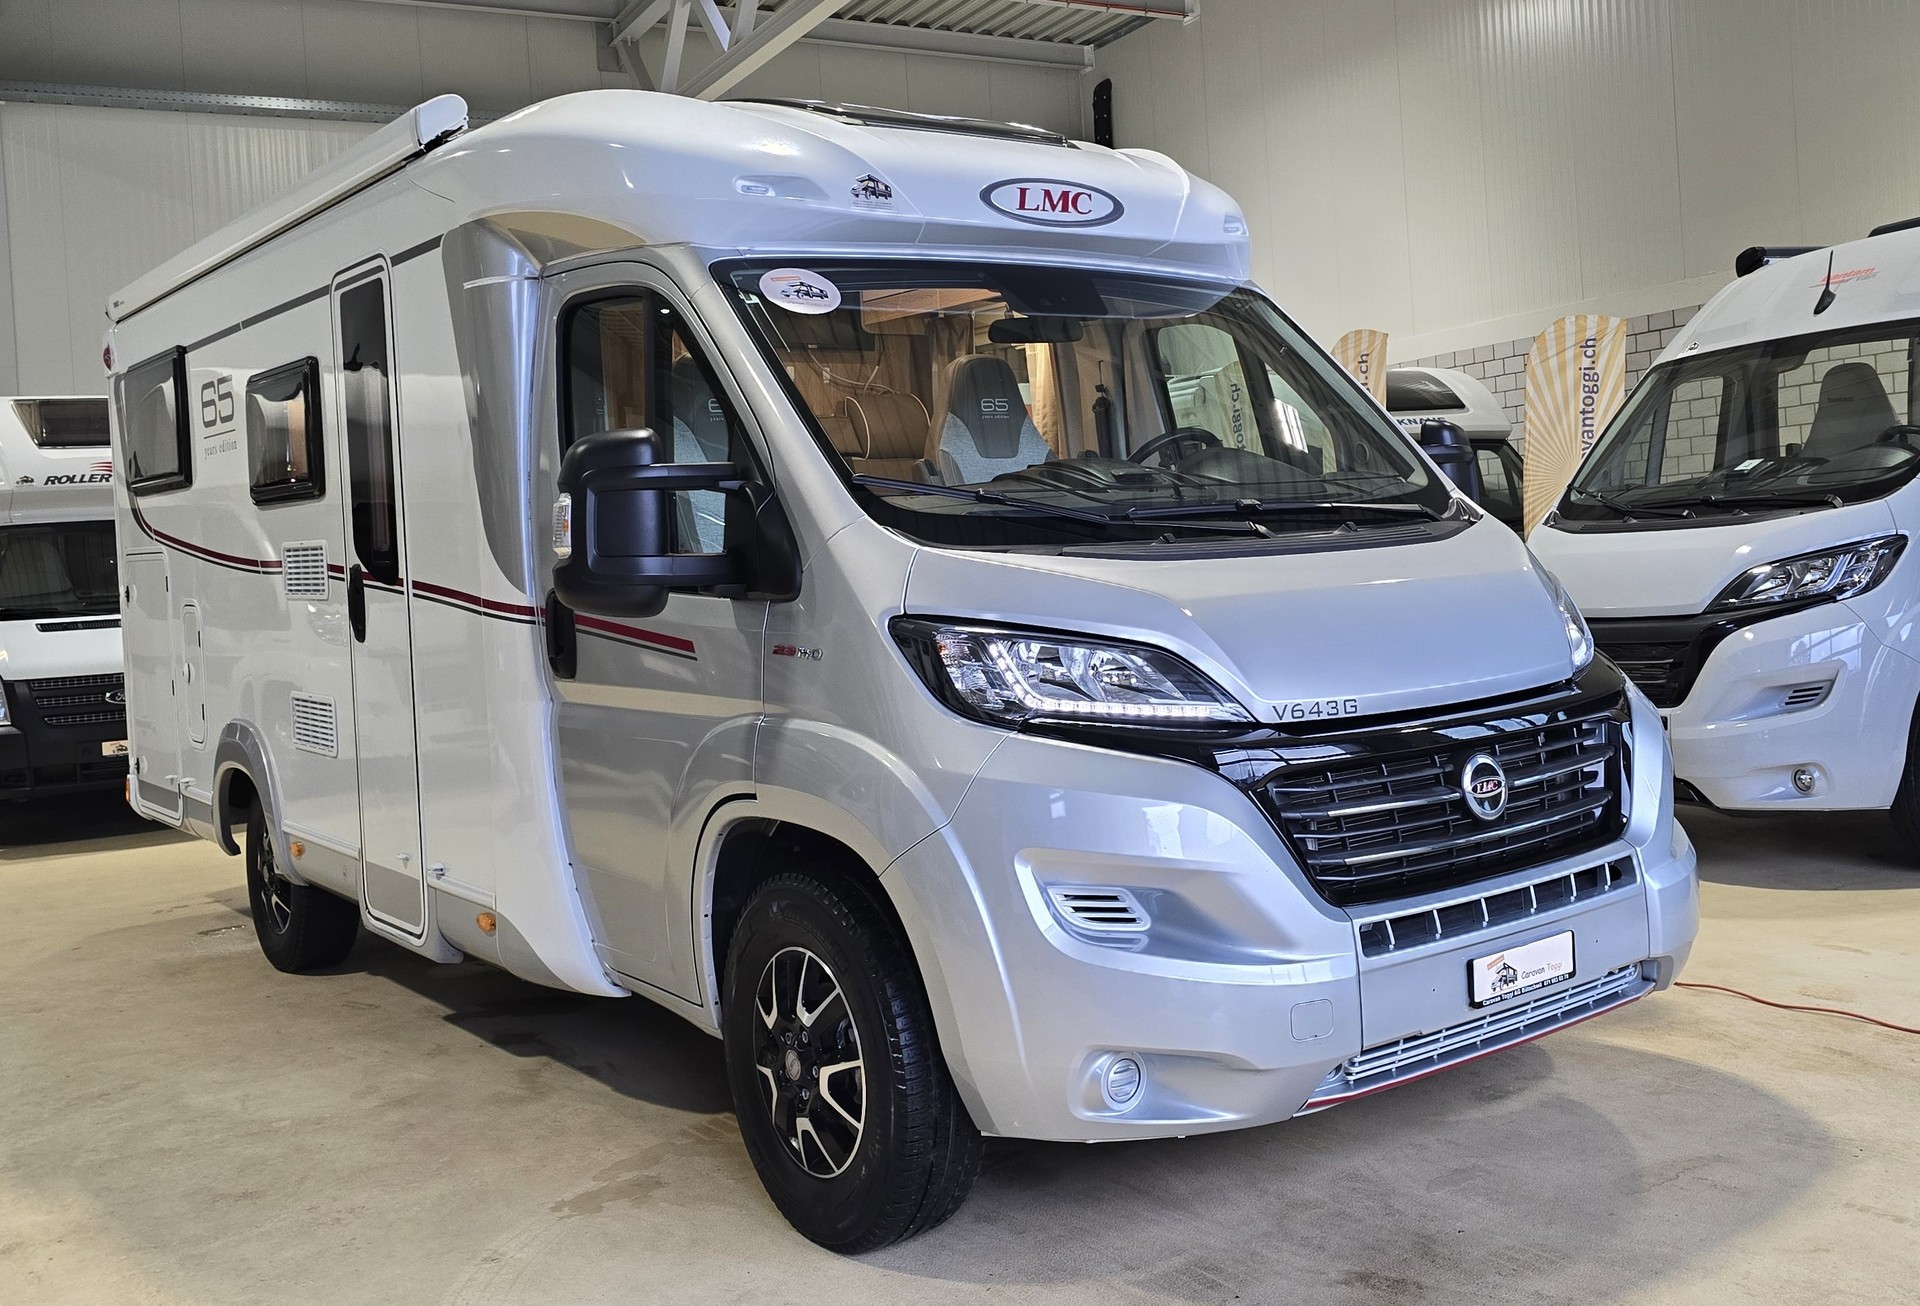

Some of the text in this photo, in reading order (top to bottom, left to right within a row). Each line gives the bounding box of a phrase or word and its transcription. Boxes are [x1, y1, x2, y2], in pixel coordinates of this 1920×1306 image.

[1016, 187, 1093, 215] LMC
[201, 374, 234, 428] 65
[981, 398, 1009, 411] 65
[43, 474, 113, 485] ROLLER
[1272, 699, 1358, 720] V643G
[1521, 967, 1545, 979] Caravan
